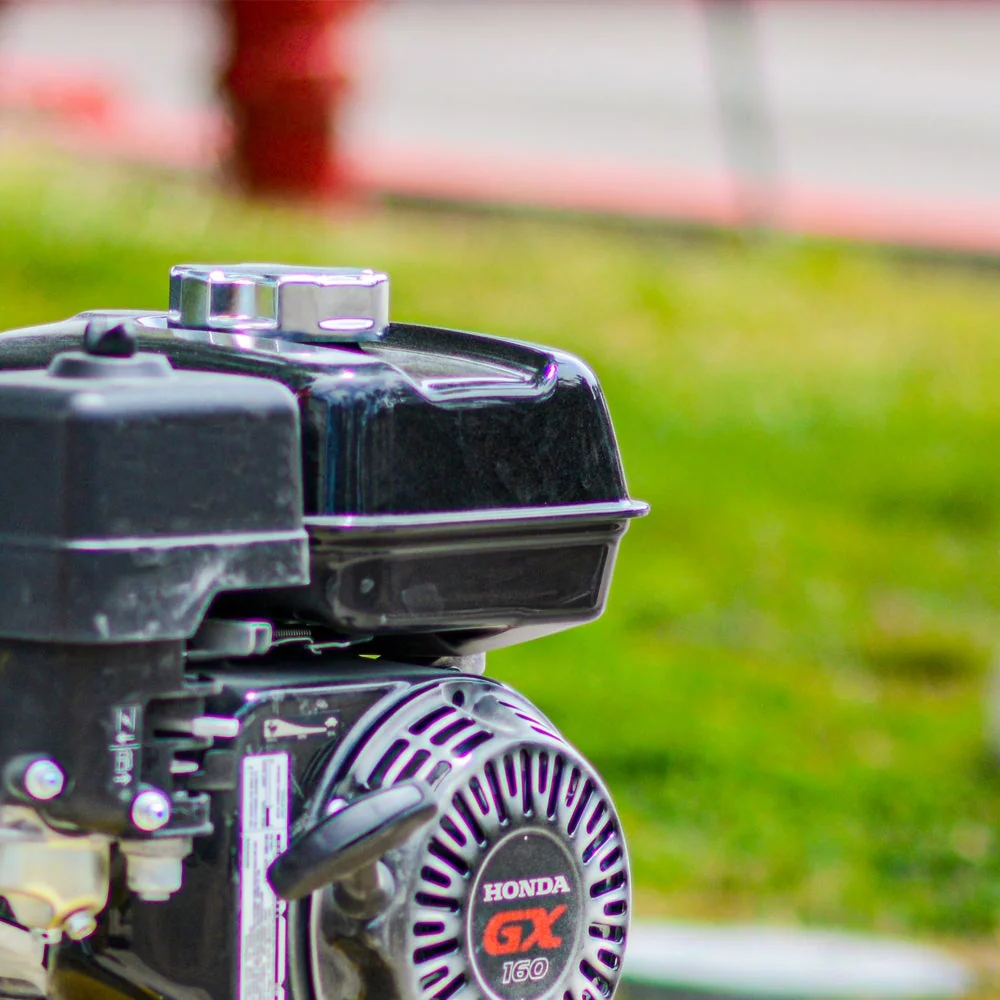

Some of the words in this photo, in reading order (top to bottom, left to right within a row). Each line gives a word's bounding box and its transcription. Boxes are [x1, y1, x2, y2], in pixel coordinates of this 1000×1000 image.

[483, 875, 571, 902] HONDA
[482, 904, 567, 956] GX
[502, 957, 549, 985] 160
